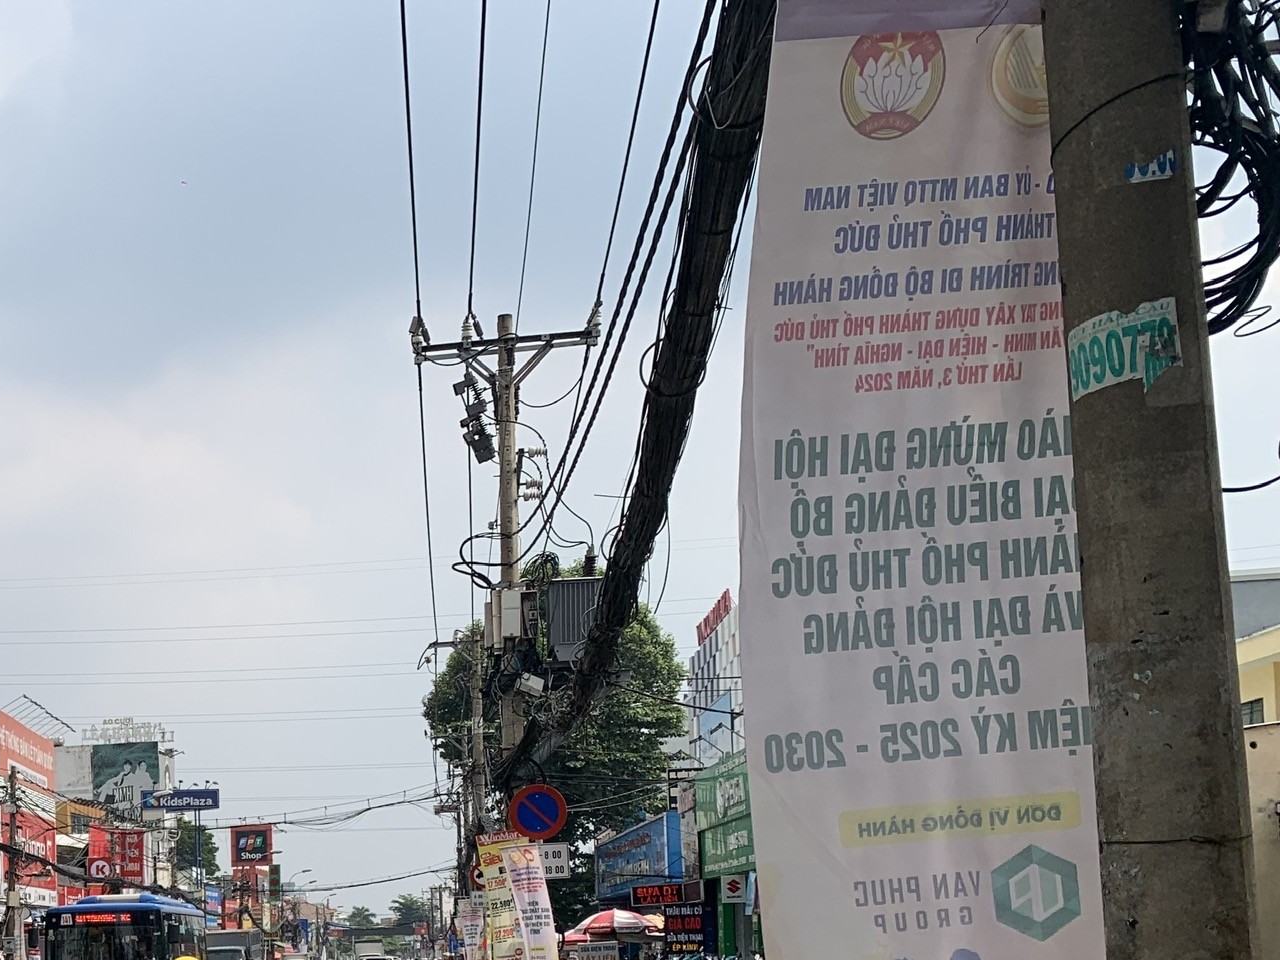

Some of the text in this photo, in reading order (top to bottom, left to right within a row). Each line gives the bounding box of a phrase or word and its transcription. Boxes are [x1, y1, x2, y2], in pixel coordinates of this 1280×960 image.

[160, 796, 212, 807] KidsPlaza
[239, 836, 263, 848] FPT
[241, 852, 261, 860] Shop
